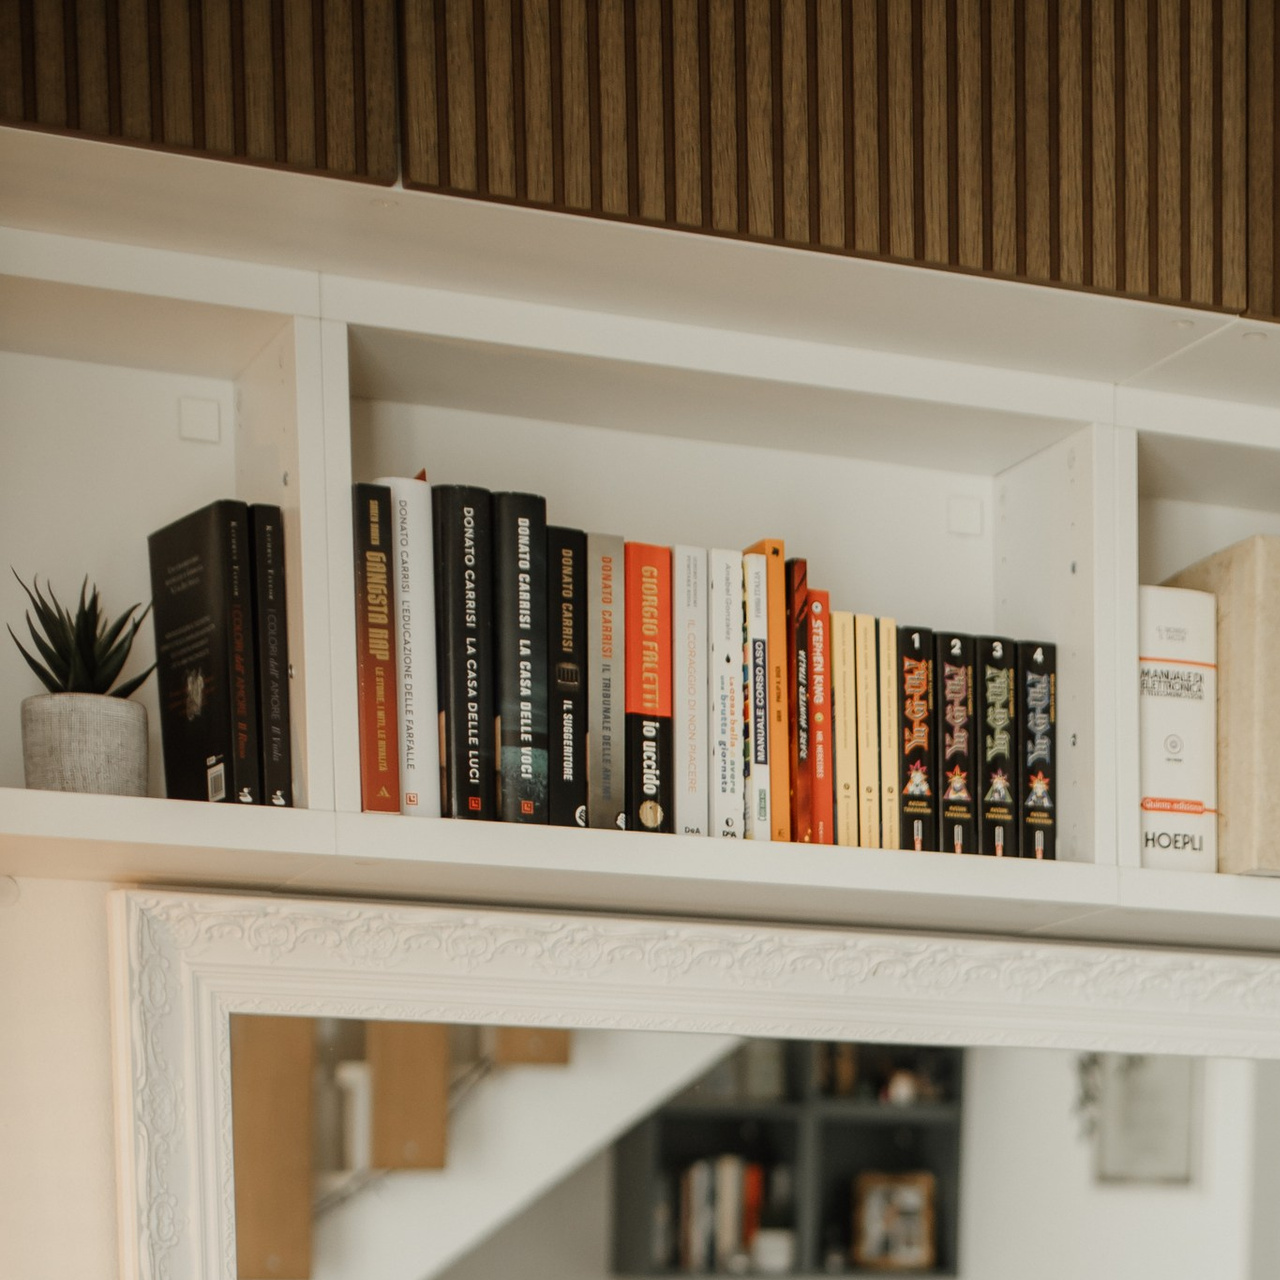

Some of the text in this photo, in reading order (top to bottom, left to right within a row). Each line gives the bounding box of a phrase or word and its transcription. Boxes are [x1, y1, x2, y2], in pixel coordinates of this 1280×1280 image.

[366, 551, 388, 624] GANGSTA
[561, 549, 573, 652] DONATO CARRISI
[601, 556, 612, 604] DONATO
[267, 614, 277, 656] COLORI
[368, 628, 389, 660] RAP
[398, 500, 415, 770] DONATO CARRISI L'EDUCAZIONE DELLE FARFALLE
[463, 507, 479, 783] DONATO CARRISI LA CASA DELLE LUCI
[517, 517, 532, 778] DONATO CARRISI LA CASA DELLE VOCI
[601, 610, 613, 659] CARRISI
[641, 566, 659, 708] GIORGIO FALETTI
[911, 632, 921, 649] 1
[950, 638, 962, 656] 2
[992, 641, 1003, 659] 3
[1033, 647, 1044, 664] 4
[375, 667, 384, 676] LE
[602, 664, 612, 673] IL
[798, 650, 807, 684] ITALIA
[812, 619, 825, 704] STEPHEN KING
[270, 680, 280, 720] AMORE
[602, 677, 612, 731] TRIBUNALE
[687, 620, 697, 794] IL CORAGGIO DI NON PIACERE
[720, 694, 728, 735] brutta
[754, 641, 766, 761] MANUALE CORSO ASO
[799, 685, 807, 728] HUNTER
[377, 730, 386, 739] LE
[563, 699, 573, 781] IL SUGGERITORE
[602, 735, 612, 764] DELLE
[730, 719, 738, 748] bella
[642, 721, 660, 794] io uccido
[718, 740, 729, 793] giornata
[1144, 831, 1203, 851] HOEPLI
